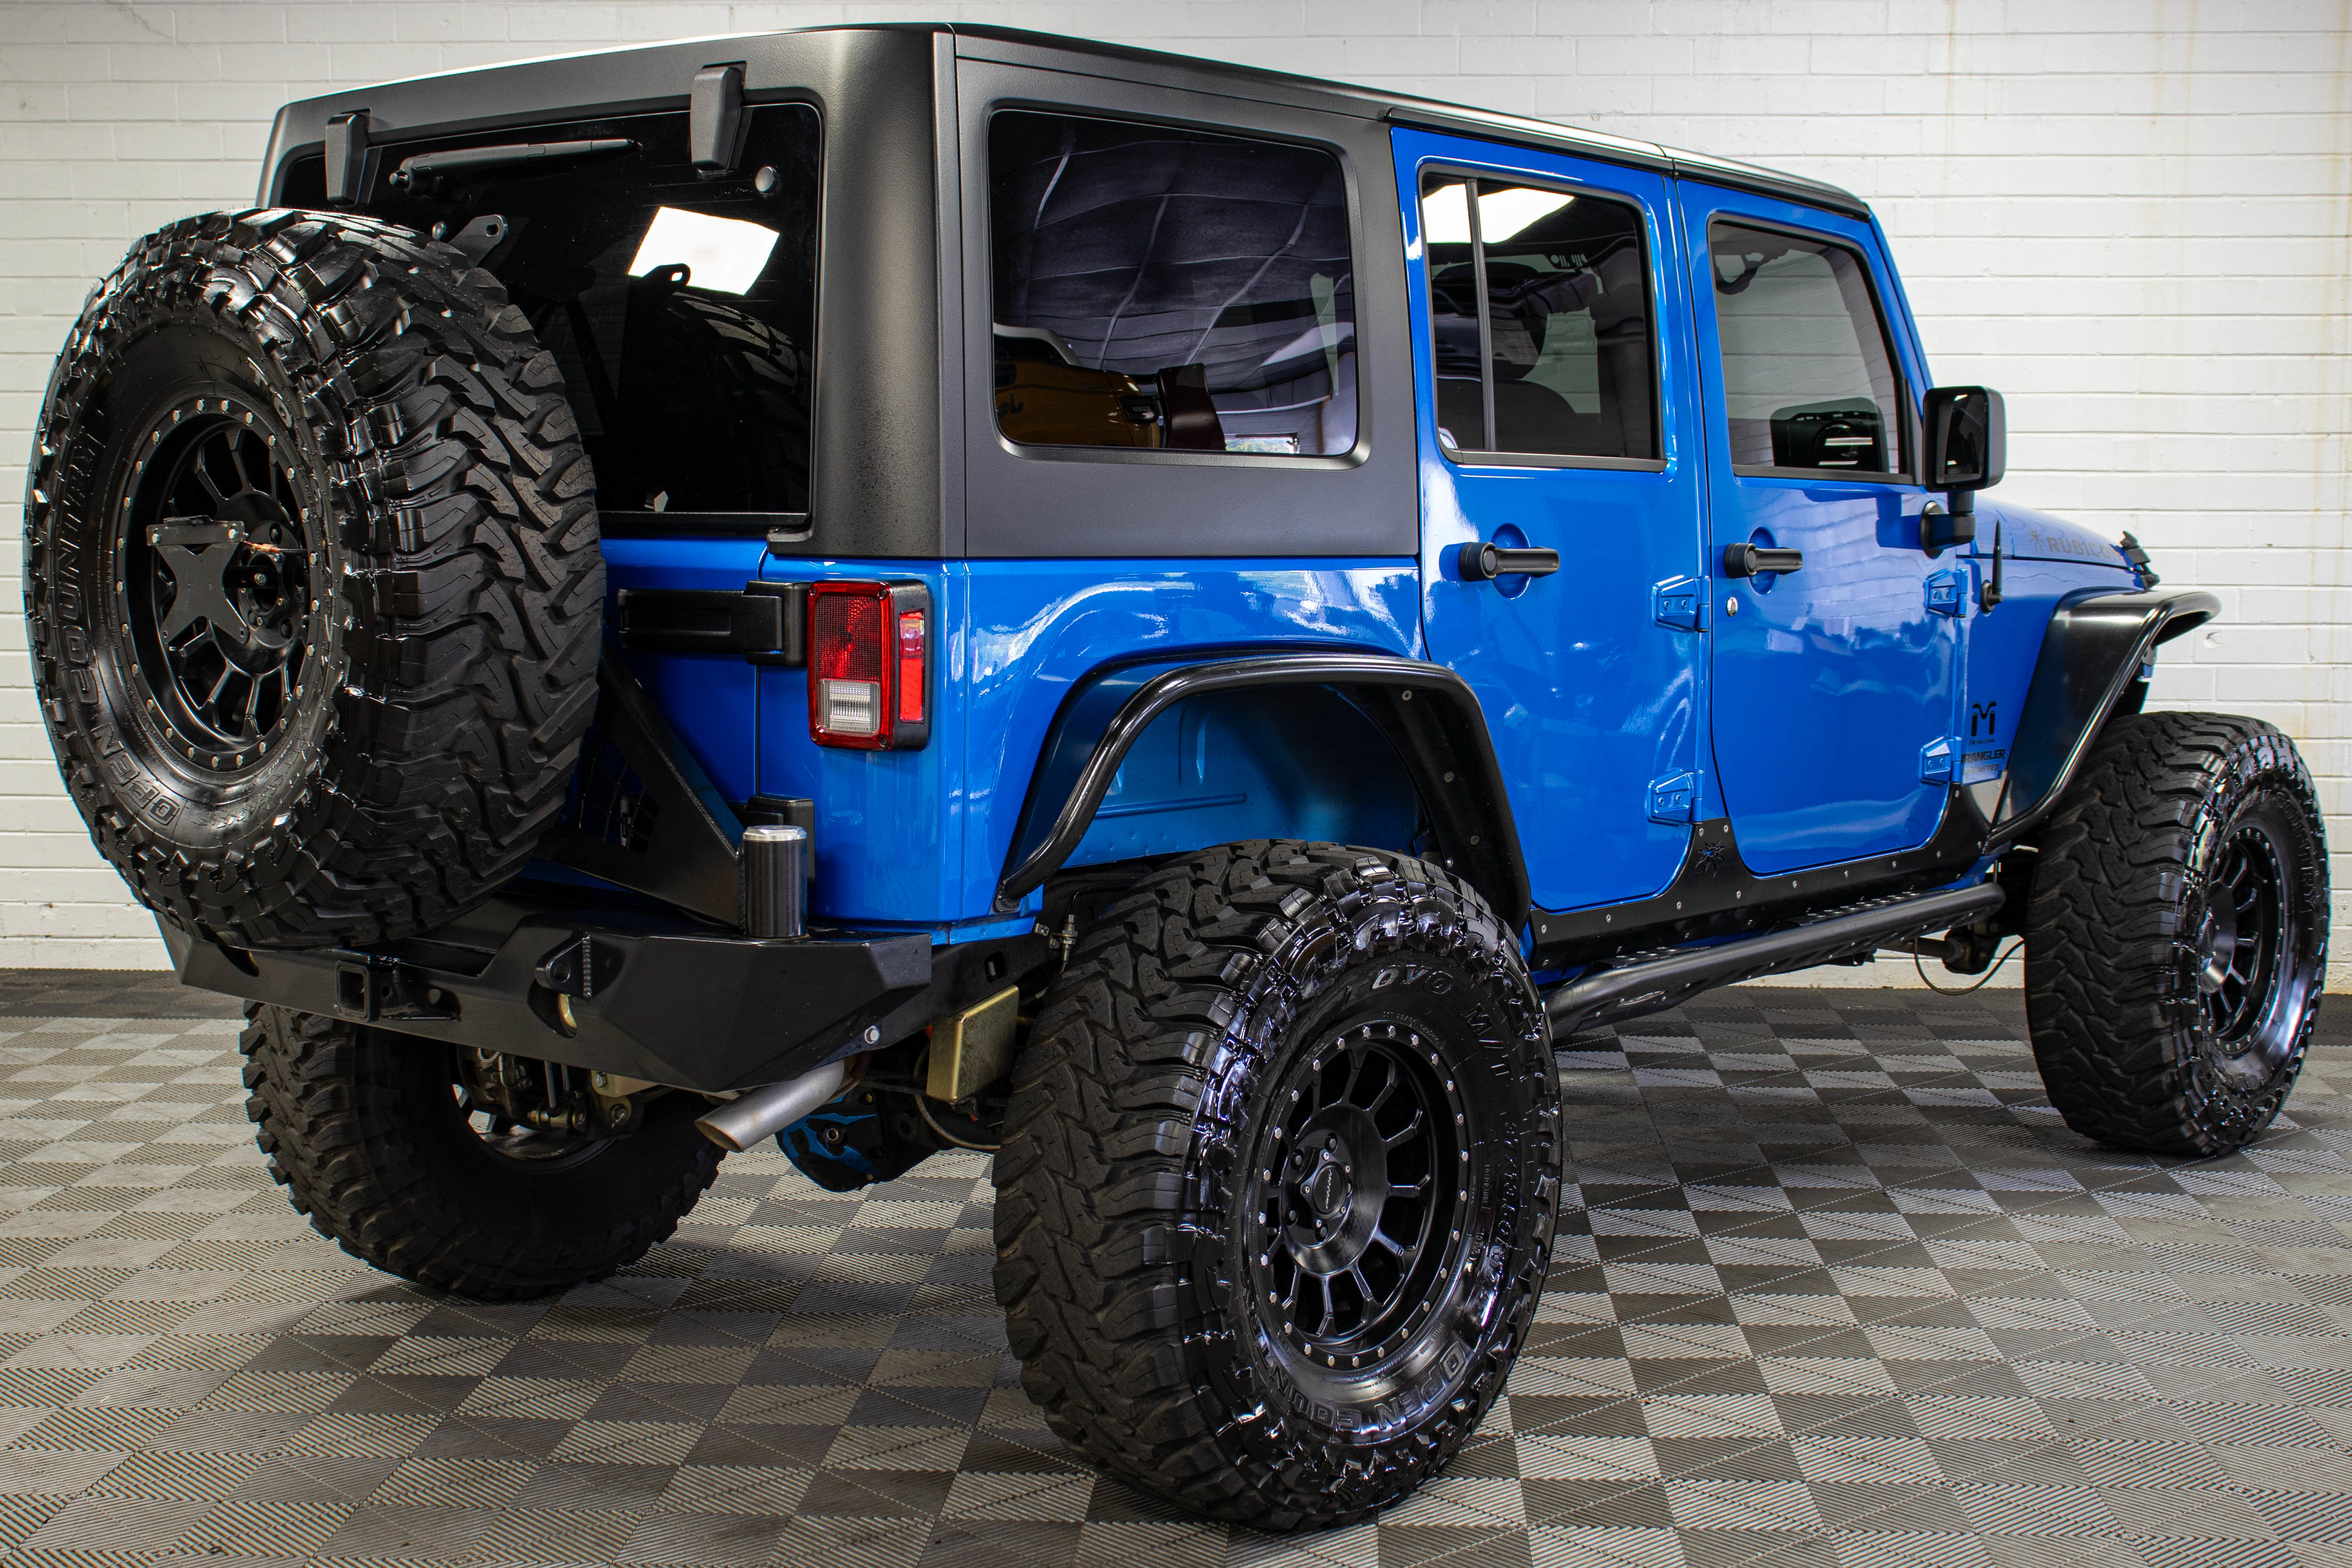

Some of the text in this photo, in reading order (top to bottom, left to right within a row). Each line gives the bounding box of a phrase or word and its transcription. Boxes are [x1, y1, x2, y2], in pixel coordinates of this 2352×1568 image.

[2047, 536, 2122, 561] RUBICON
[91, 722, 179, 825] OPEN
[1374, 1341, 1467, 1431] OPEN
